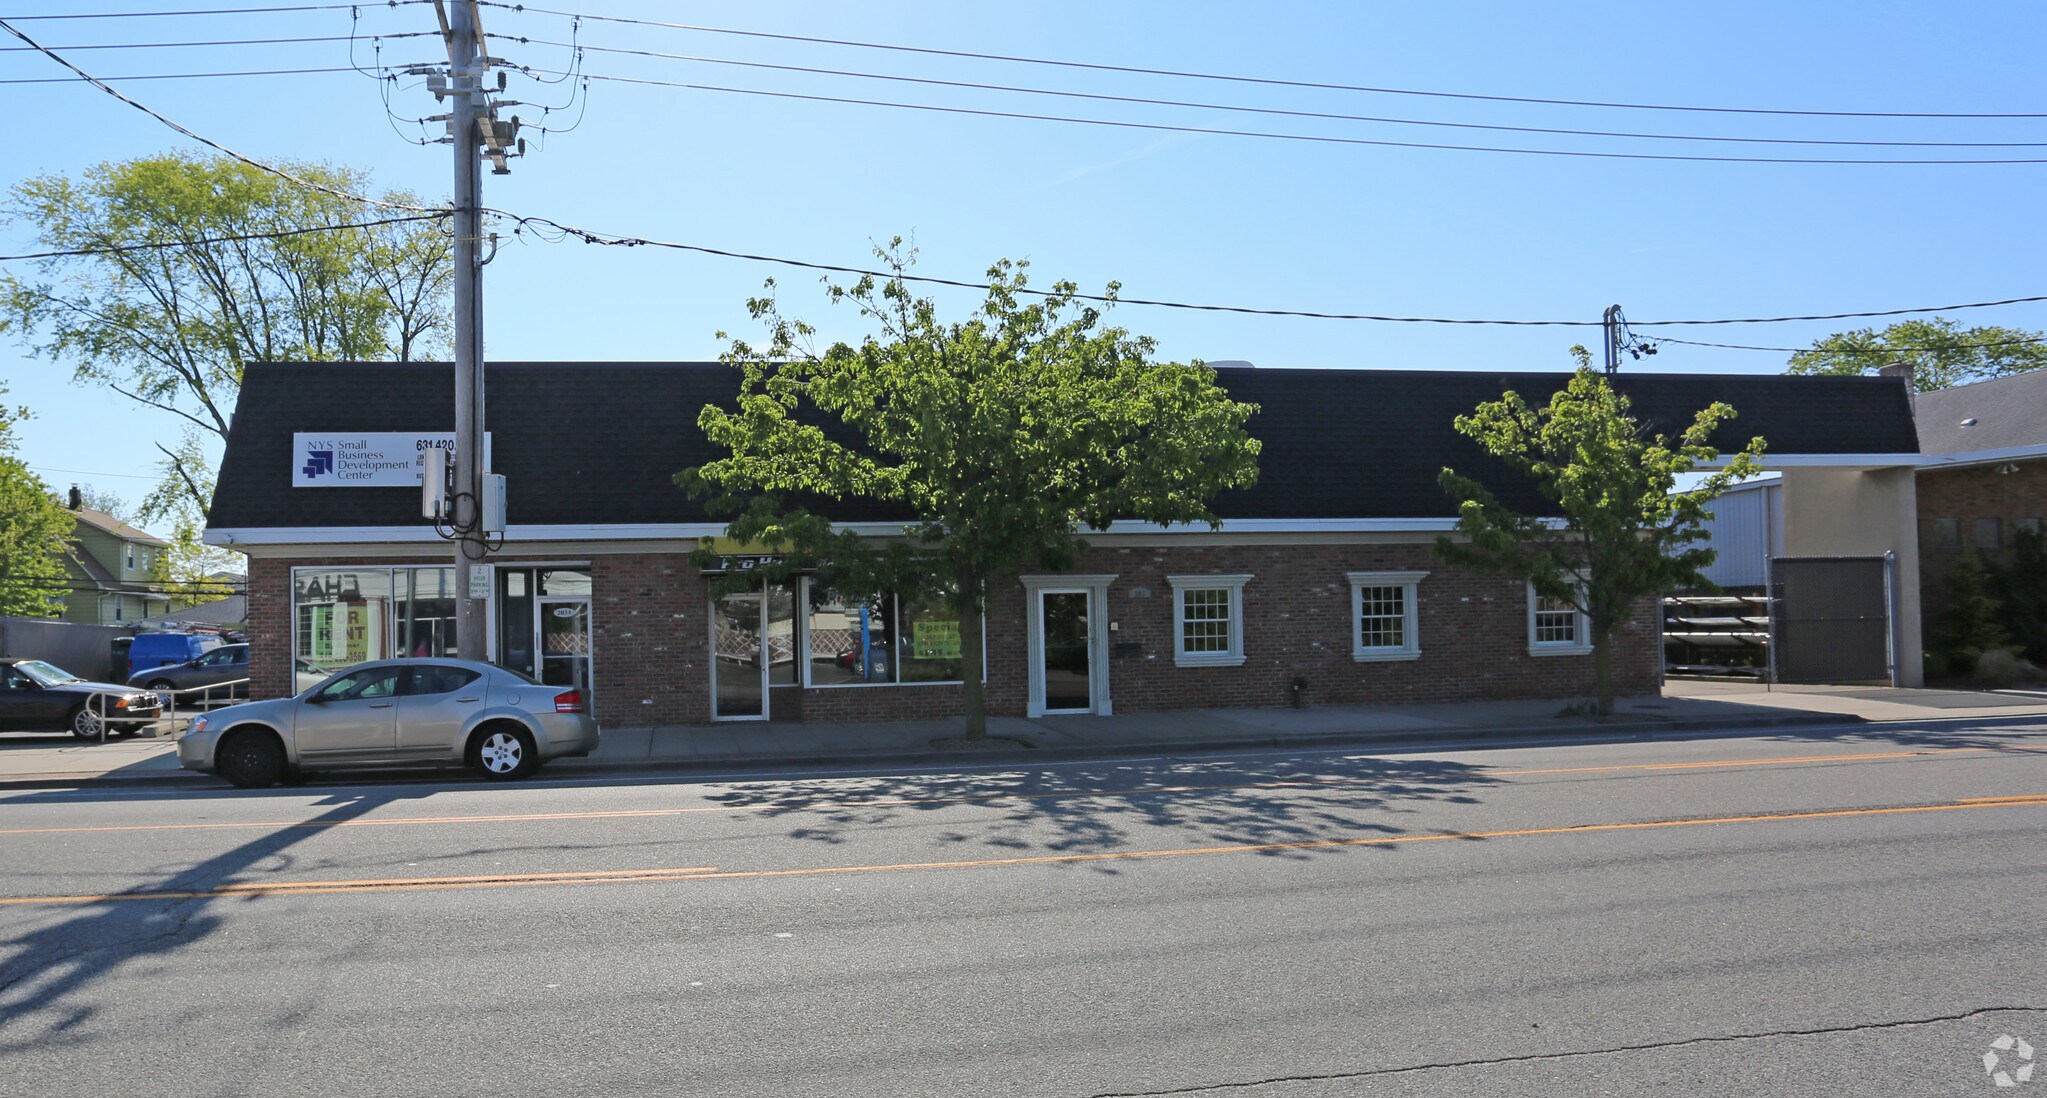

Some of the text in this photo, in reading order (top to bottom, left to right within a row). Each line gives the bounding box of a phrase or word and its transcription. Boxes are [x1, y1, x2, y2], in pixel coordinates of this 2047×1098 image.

[307, 440, 333, 450] NYS
[338, 440, 367, 450] Small
[338, 450, 384, 460] Business
[338, 460, 409, 473] Development
[337, 470, 374, 480] Center
[477, 566, 483, 574] 2
[324, 610, 360, 625] FOR
[319, 626, 366, 641] RENT
[918, 624, 958, 633] Specia
